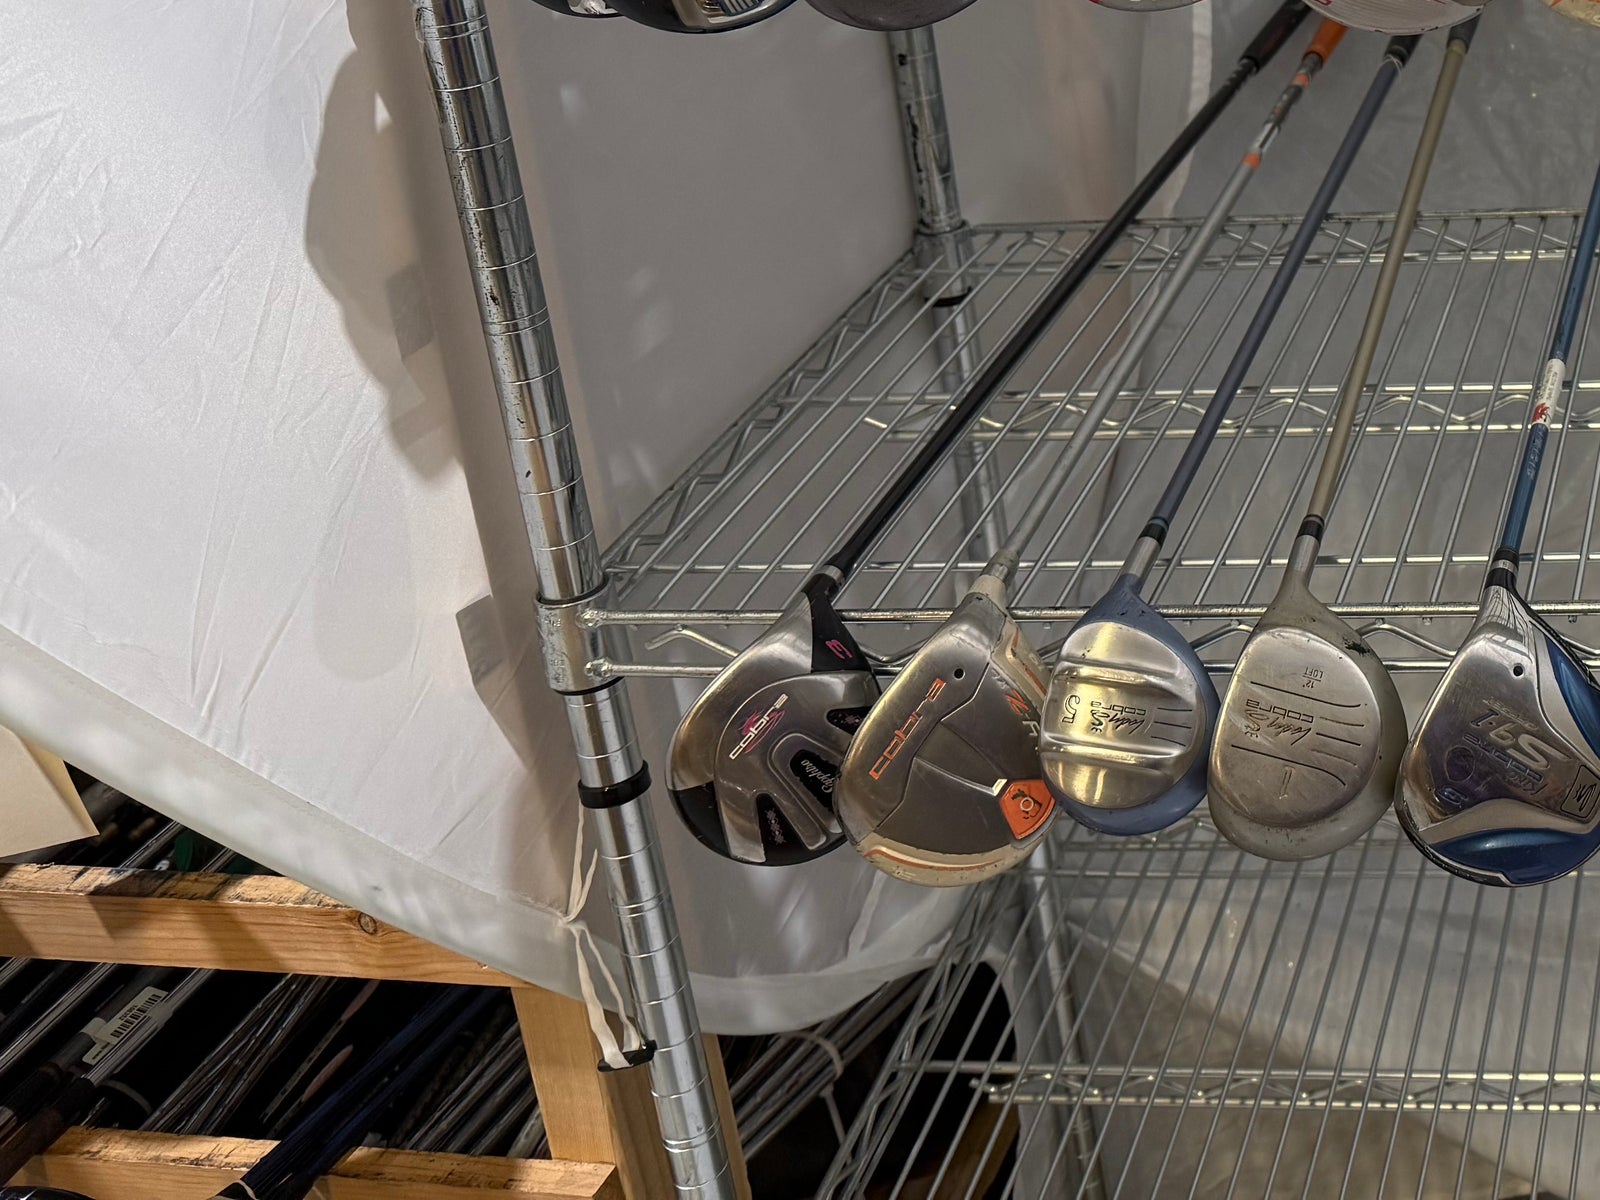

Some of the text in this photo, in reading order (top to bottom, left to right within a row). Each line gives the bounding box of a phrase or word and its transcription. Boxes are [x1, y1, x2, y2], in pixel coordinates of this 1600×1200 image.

[825, 639, 853, 660] 3
[1305, 666, 1325, 680] LOFT
[1062, 694, 1081, 724] 5
[1091, 700, 1147, 717] cobra
[1246, 698, 1314, 725] cobra
[729, 693, 788, 760] cobra
[868, 677, 947, 780] cobra
[1108, 713, 1147, 735] Lady
[1266, 716, 1312, 746] Lady
[1463, 731, 1544, 784] cobra
